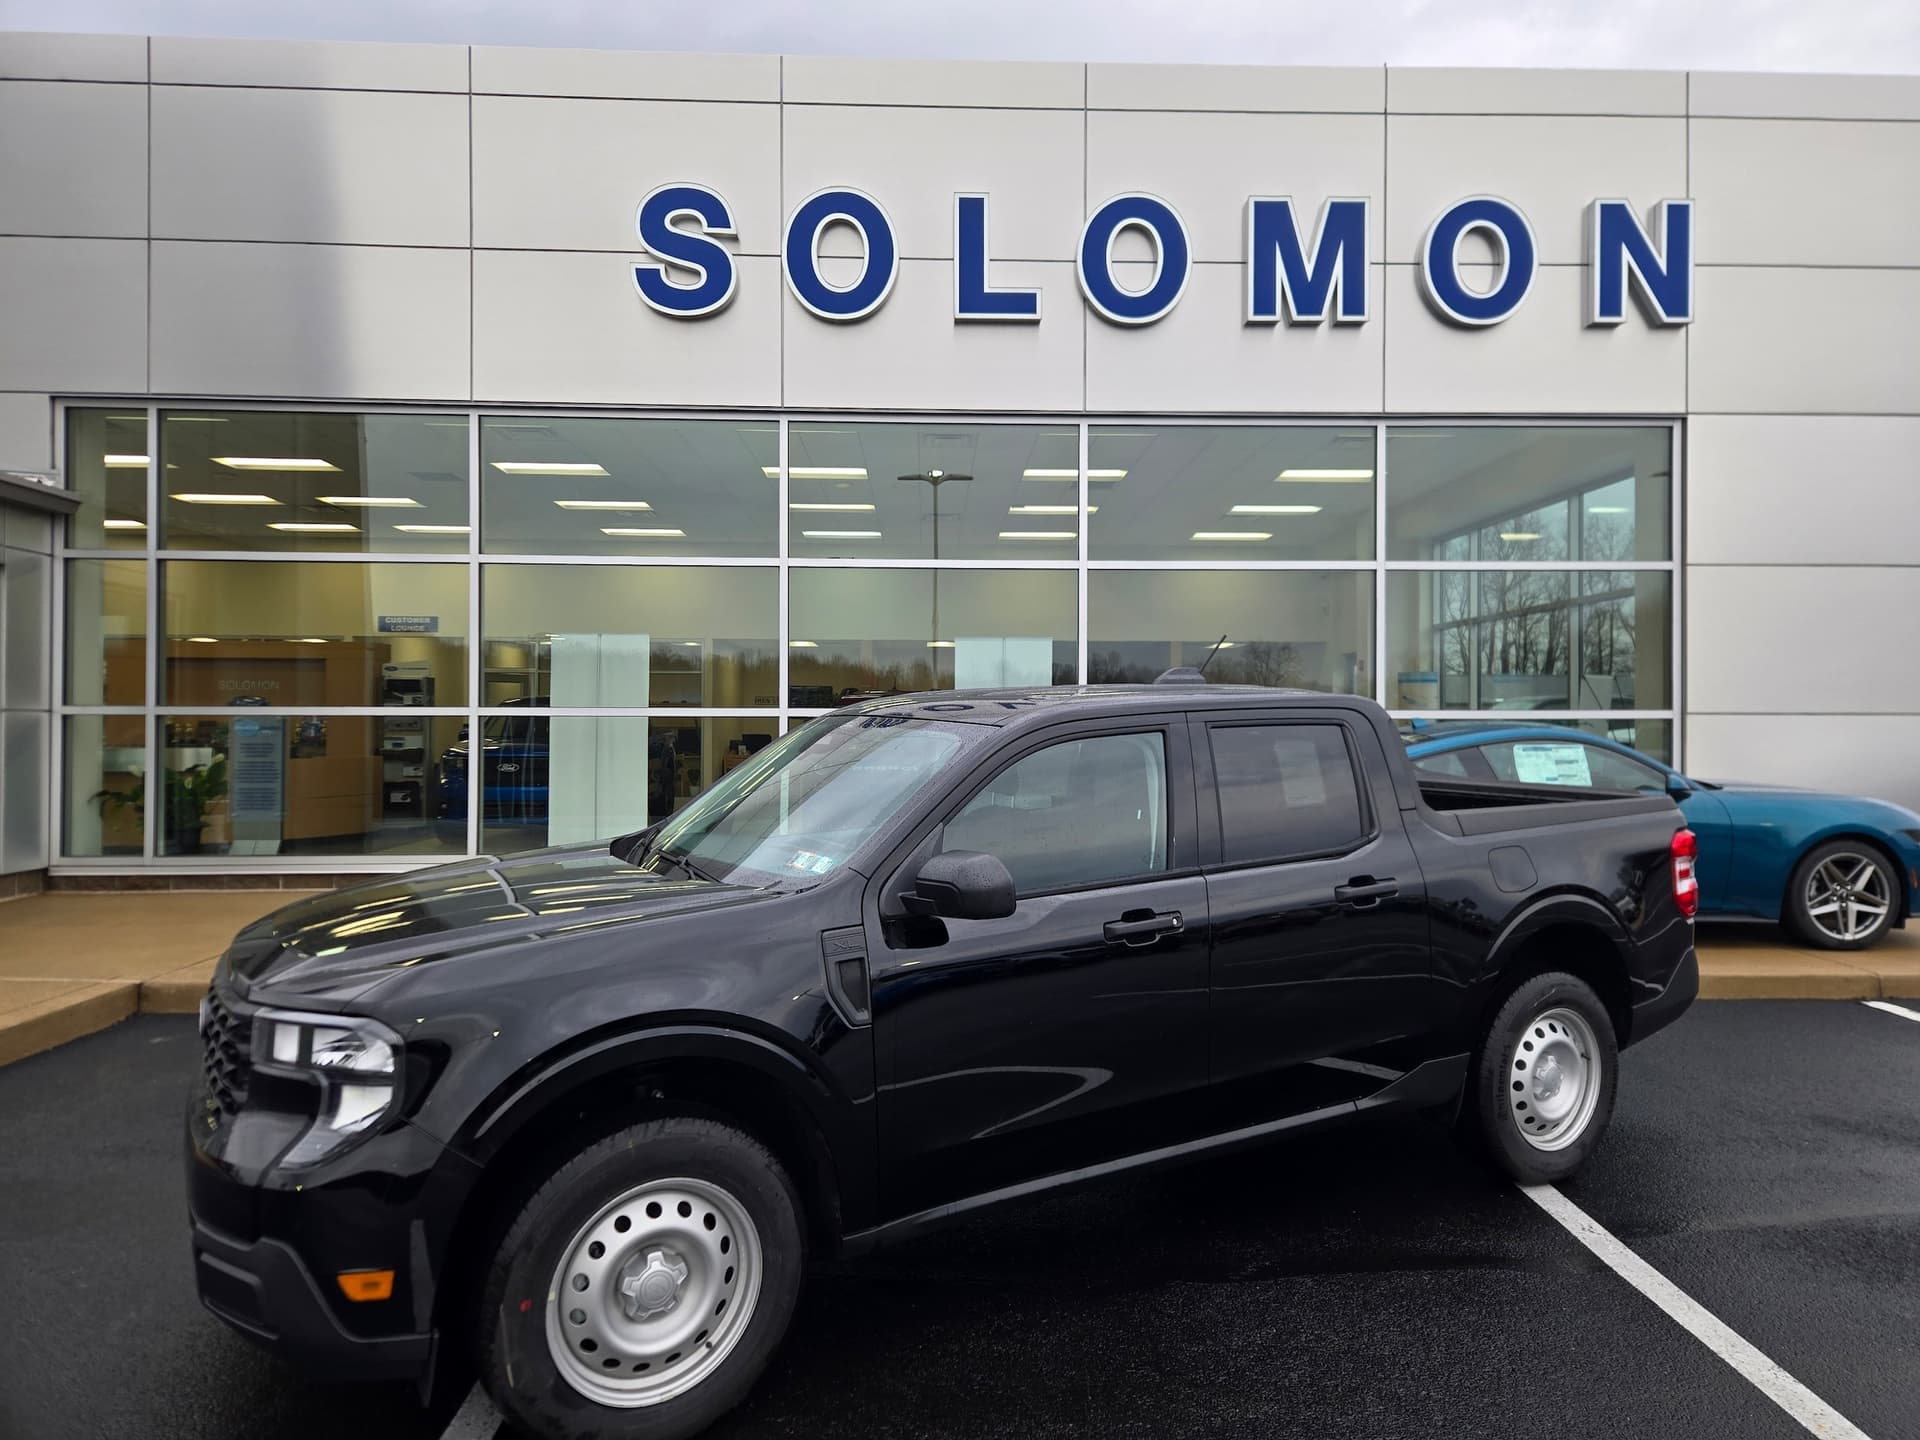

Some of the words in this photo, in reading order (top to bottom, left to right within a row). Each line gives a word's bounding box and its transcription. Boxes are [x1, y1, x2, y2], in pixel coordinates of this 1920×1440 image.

[630, 182, 1695, 326] SOLOMON
[384, 616, 431, 624] CUSTOMER
[218, 679, 281, 690] SOLOMON
[499, 763, 519, 772] Ford
